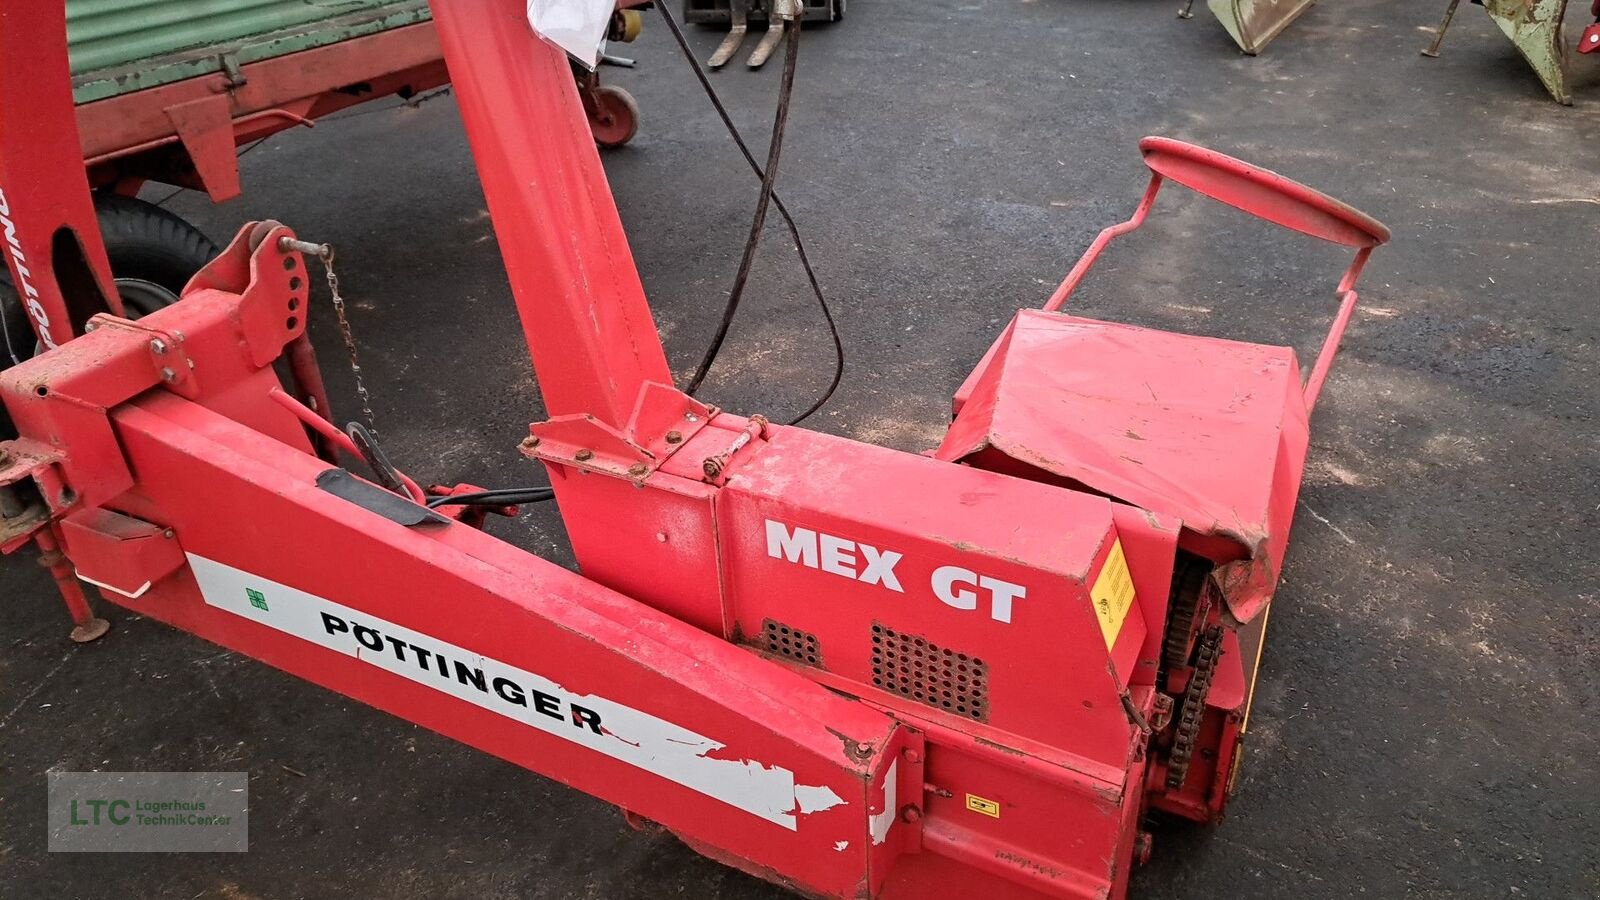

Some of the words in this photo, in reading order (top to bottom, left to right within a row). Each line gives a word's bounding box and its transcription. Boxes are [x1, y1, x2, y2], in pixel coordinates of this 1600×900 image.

[765, 518, 904, 593] MEX
[931, 565, 1026, 624] GT
[320, 611, 604, 736] PÖTTINGER
